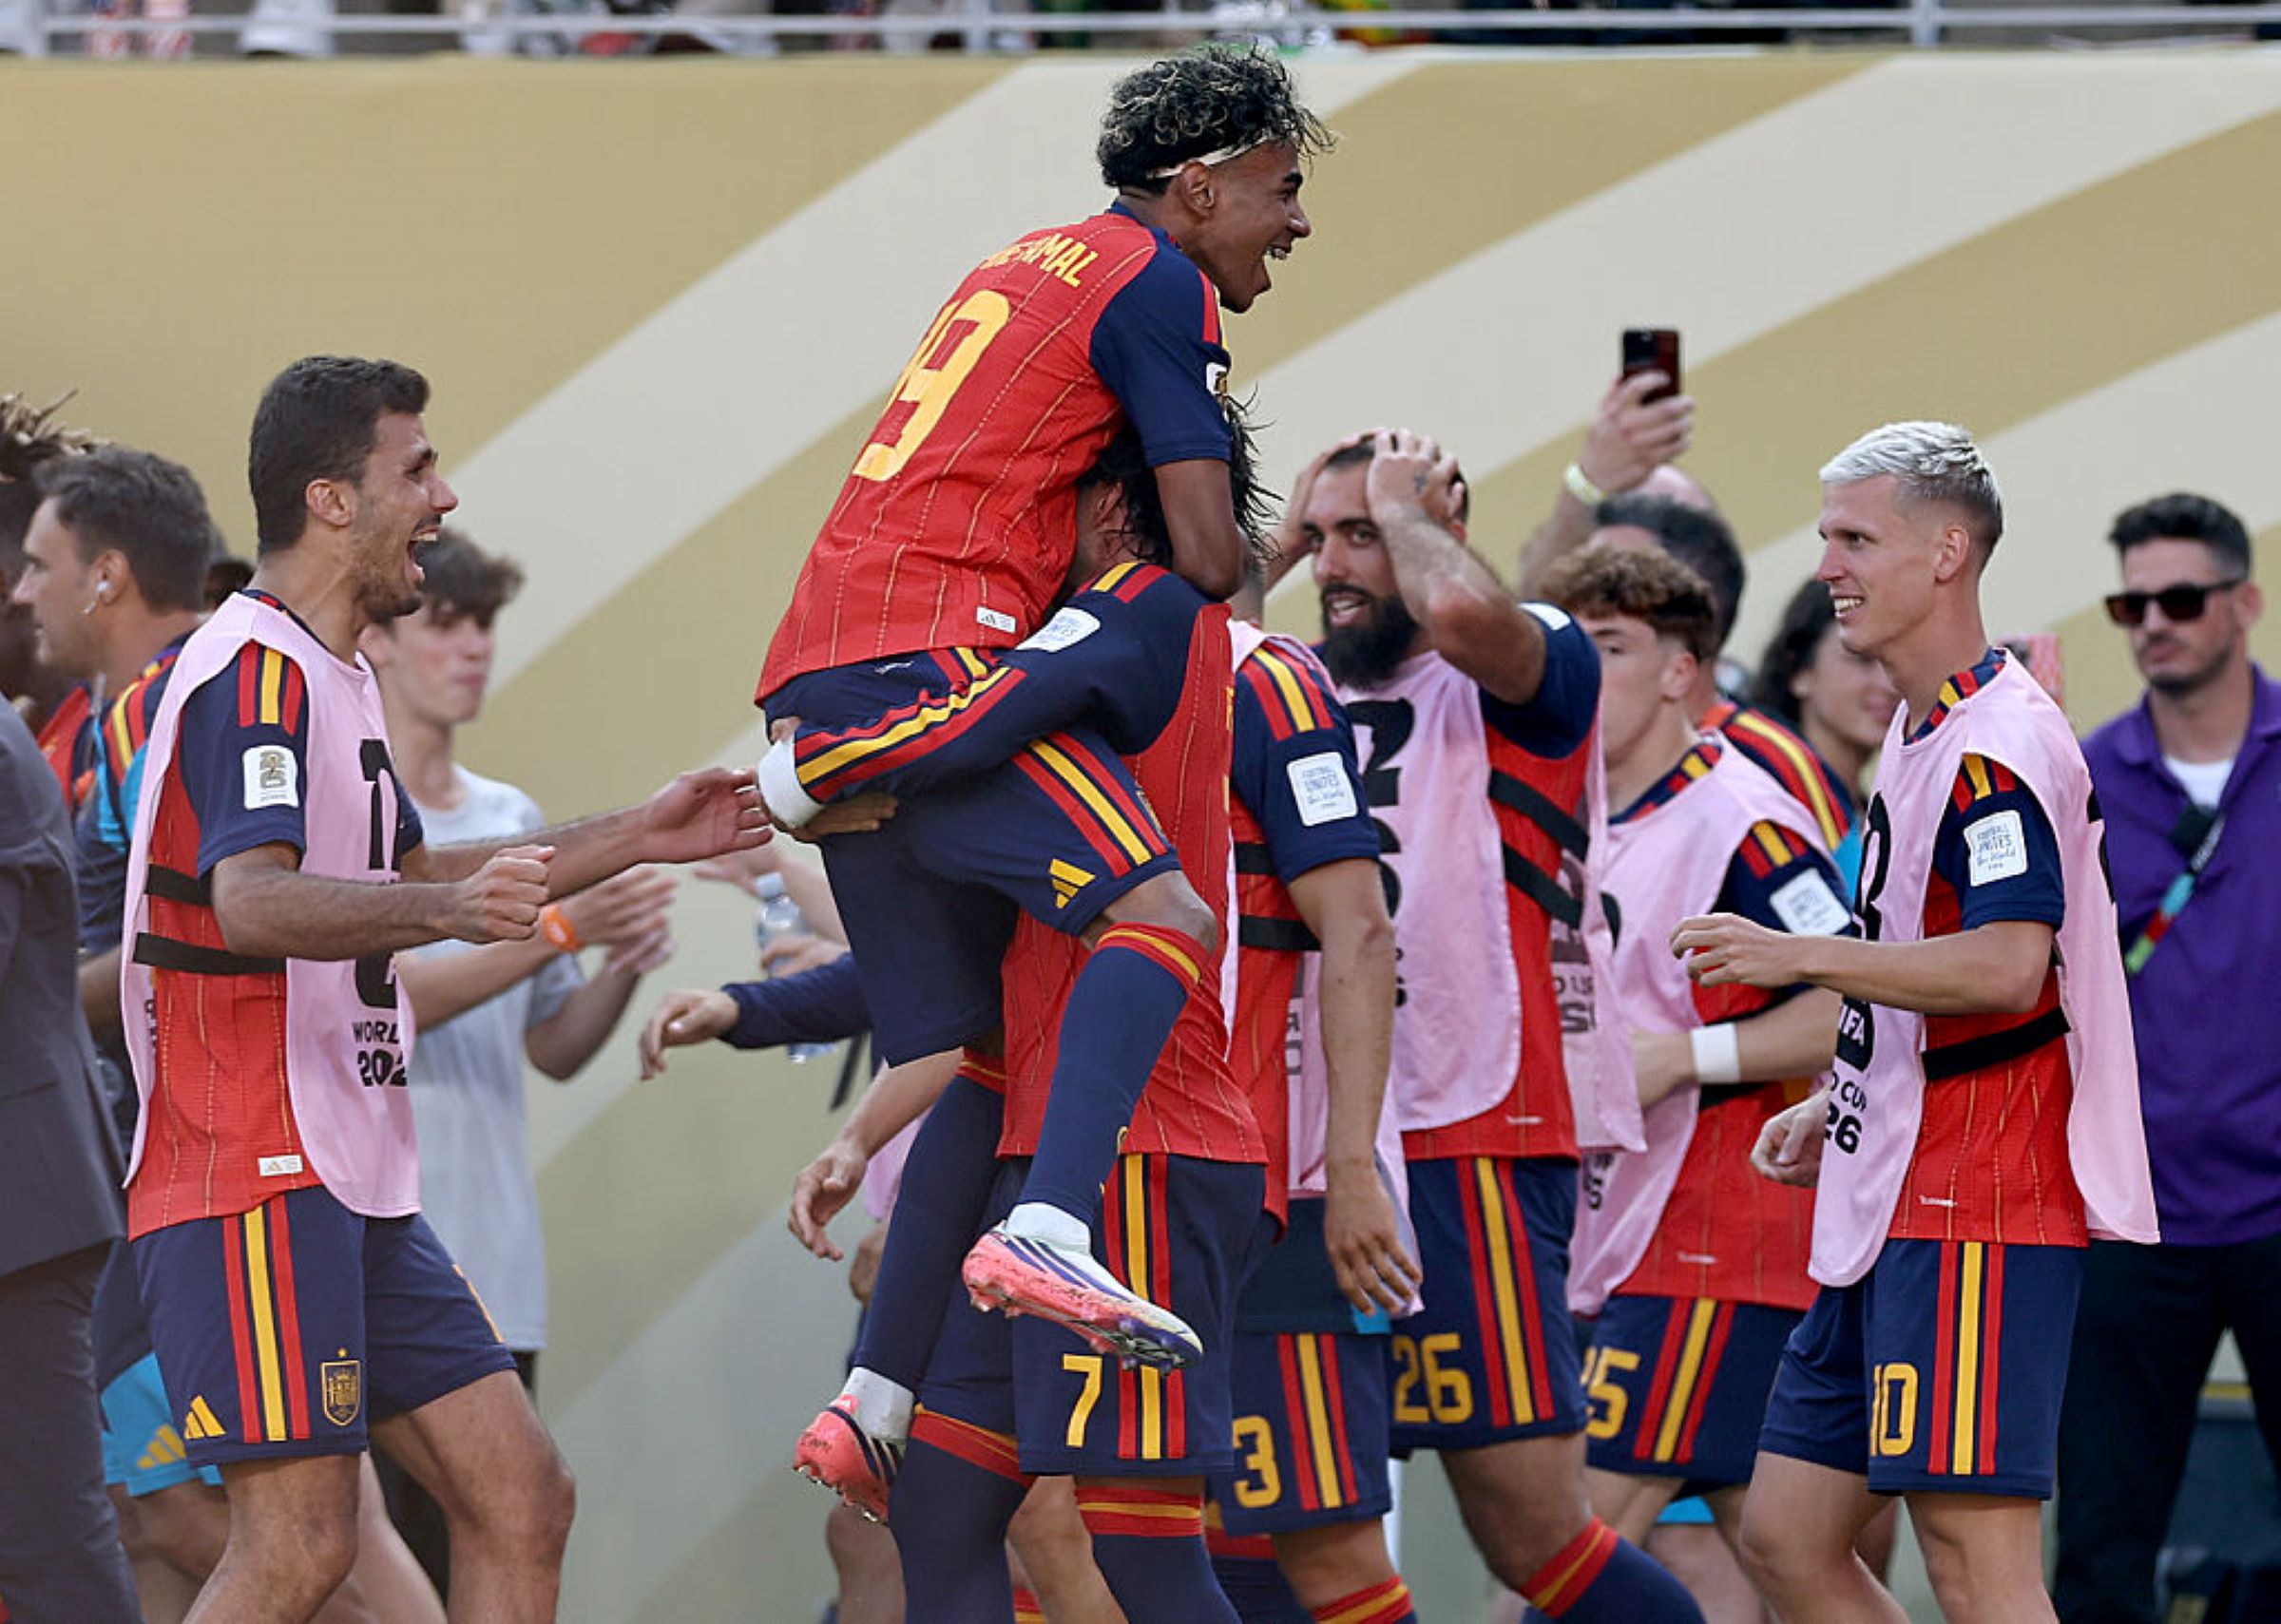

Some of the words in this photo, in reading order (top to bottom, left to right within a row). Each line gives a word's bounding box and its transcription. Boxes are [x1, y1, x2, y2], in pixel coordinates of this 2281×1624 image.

[352, 1020, 400, 1044] WORL
[357, 1048, 408, 1087] 202
[1838, 1003, 1866, 1047] IFA
[1063, 1353, 1102, 1447] 7
[1391, 1333, 1473, 1424] 26
[1869, 1362, 1918, 1458] 10
[1232, 1415, 1281, 1508] 3
